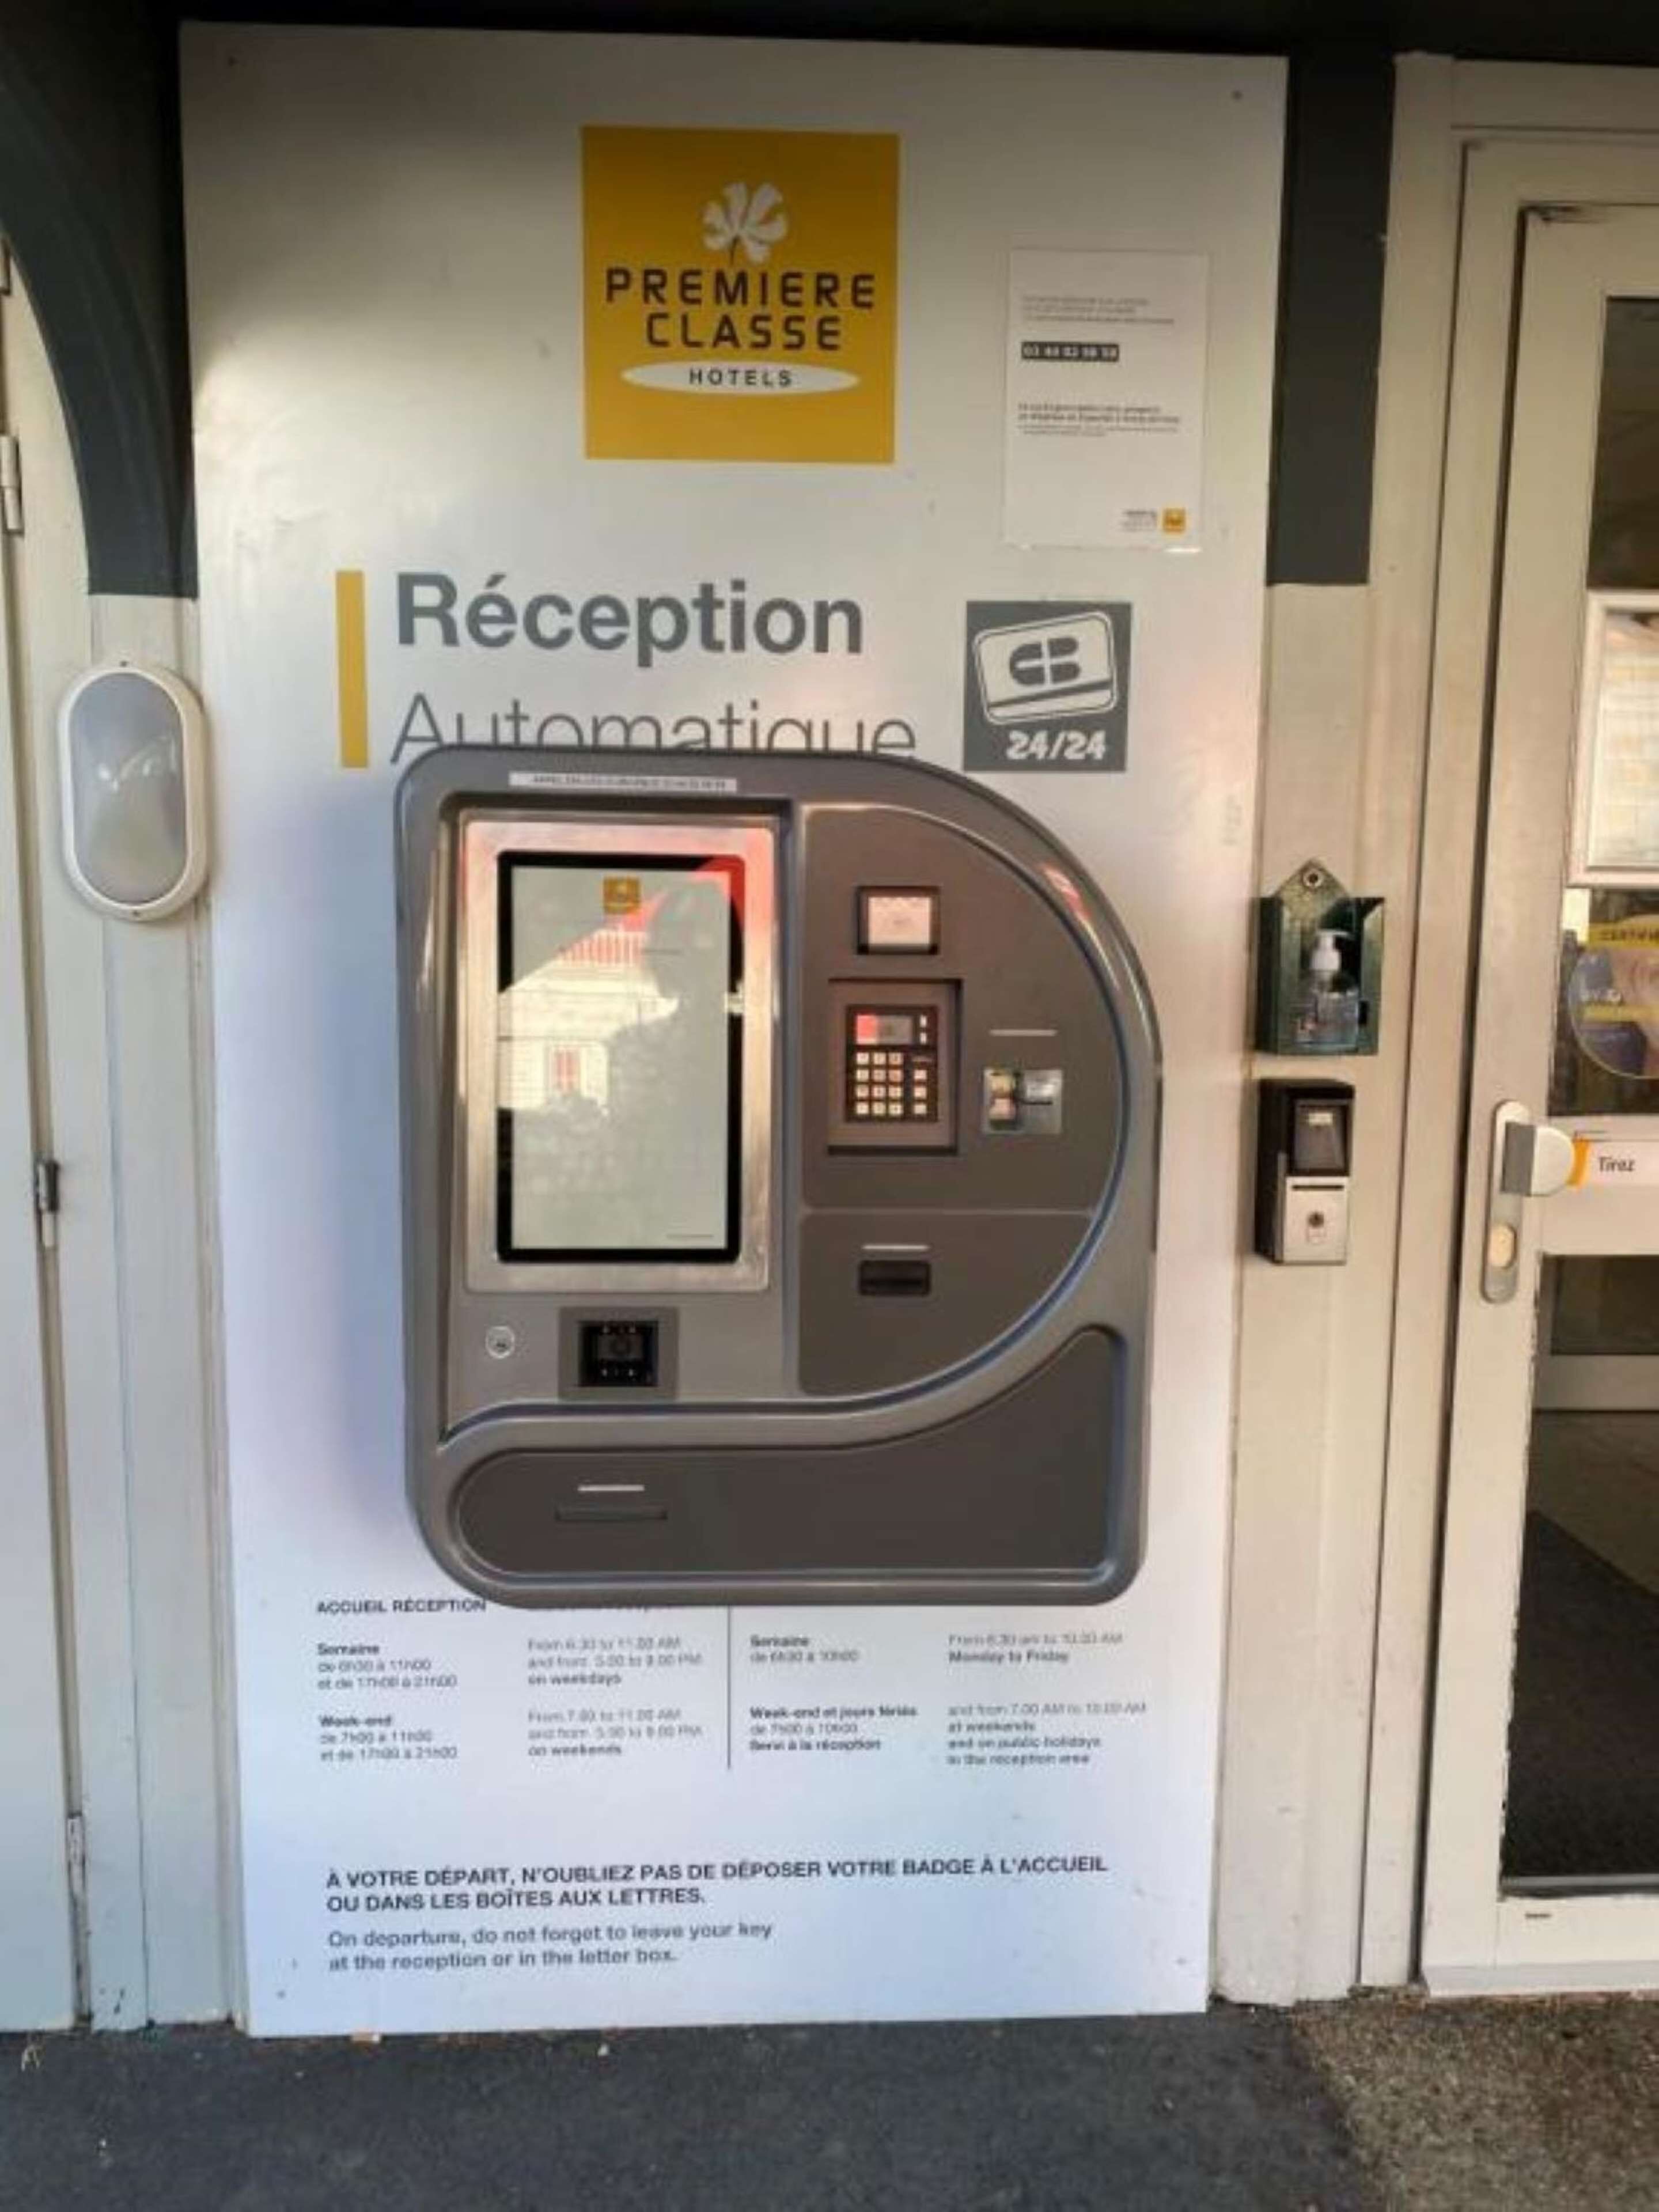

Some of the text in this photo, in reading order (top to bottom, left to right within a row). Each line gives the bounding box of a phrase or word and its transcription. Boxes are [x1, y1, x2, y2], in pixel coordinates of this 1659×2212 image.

[605, 268, 876, 308] PREMIERE
[645, 313, 842, 350] CLASSE
[689, 368, 793, 387] HOTELS
[396, 571, 863, 669] Réception
[1006, 729, 1106, 760] 24/24
[1599, 1156, 1636, 1172] Tirez
[317, 1597, 487, 1614] ACCUEIL RÉCEPTION
[750, 1635, 810, 1647] Semaine
[317, 1643, 380, 1656] Semaine
[948, 1650, 1005, 1664] Monday
[1027, 1650, 1070, 1664] Friday
[318, 1661, 336, 1672] de
[318, 1678, 332, 1690] et
[335, 1677, 354, 1690] de
[528, 1672, 622, 1687] on weekdays
[750, 1706, 820, 1719] Week-end
[823, 1706, 838, 1719] et
[840, 1707, 875, 1721] jours
[319, 1715, 393, 1728] Week-end
[948, 1719, 1036, 1732] at weekends
[750, 1738, 881, 1752] Servi à la réception
[948, 1735, 1101, 1750] and on public holidays
[528, 1744, 622, 1757] on weekends
[963, 1753, 986, 1765] the
[989, 1752, 1056, 1767] reception
[1059, 1753, 1090, 1764] area
[327, 1855, 1109, 1889] À VOTRE DÉPART, N'OUBLIEZ PAS DE DÉPOSER VOTRE BADGE À L'ACCUEIL
[327, 1887, 706, 1912] OU DANS LES BOÎTES AUX LETTRES.
[328, 1919, 773, 1949] On departure, do not forget to leave your key
[329, 1946, 679, 1974] at the reception or in the letter box.
